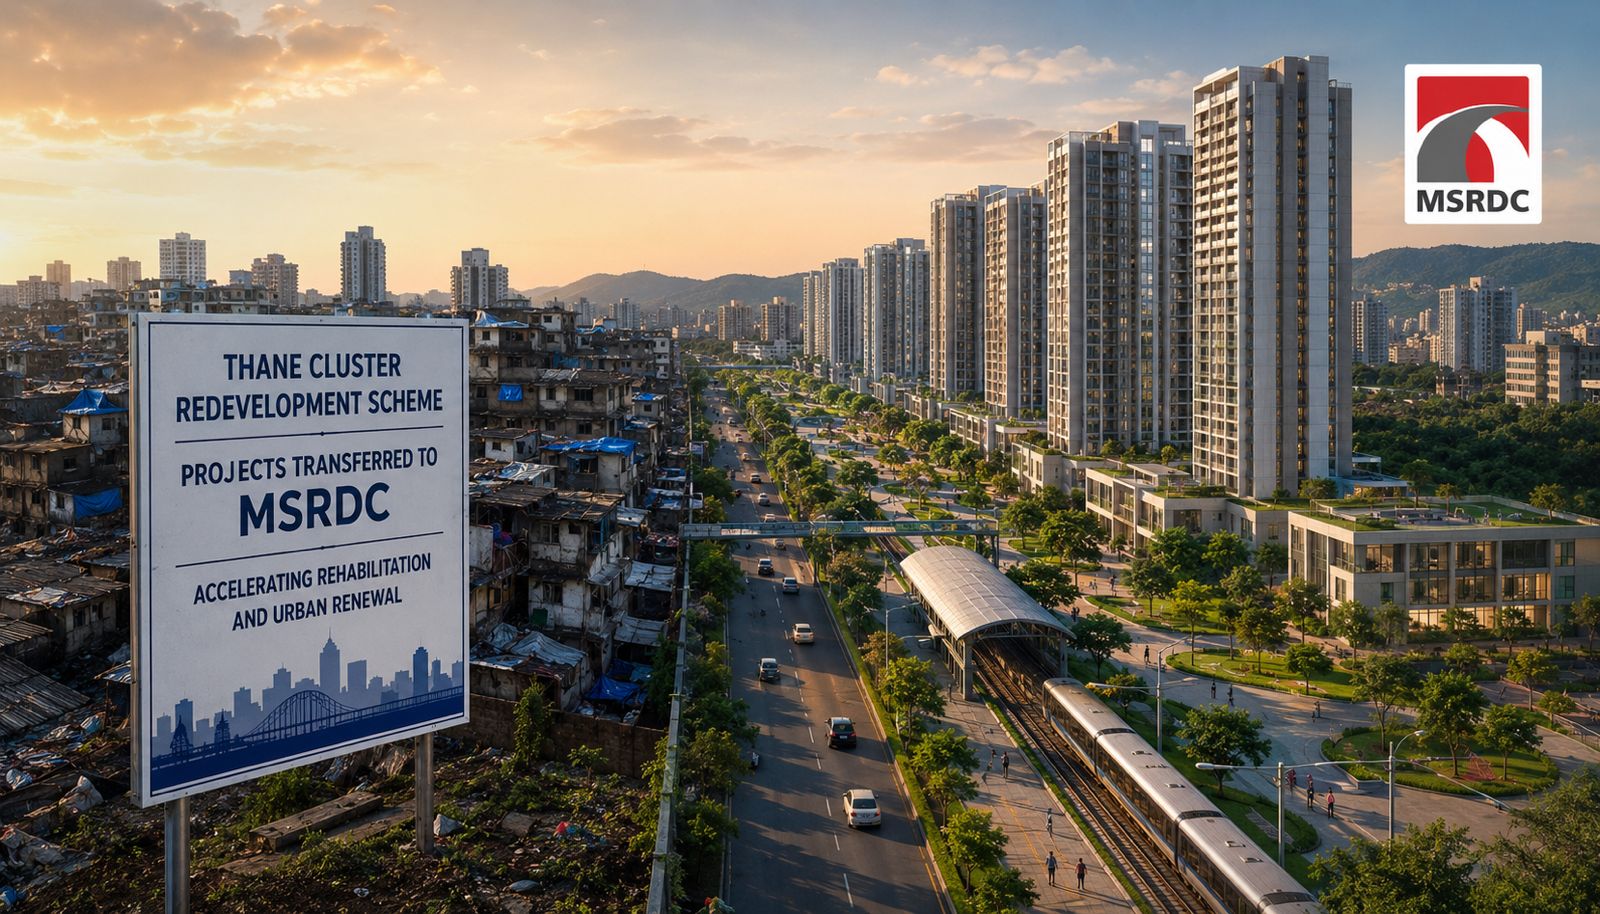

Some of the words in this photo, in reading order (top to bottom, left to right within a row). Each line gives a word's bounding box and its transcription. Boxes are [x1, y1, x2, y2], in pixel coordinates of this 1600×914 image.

[223, 354, 302, 381] THANE
[309, 353, 402, 379] CLUSTER
[176, 391, 363, 423] REDEVELOPMENT
[367, 389, 443, 415] SCHEME
[181, 457, 287, 487] PROJECTS
[291, 449, 413, 477] TRANSFERRED
[418, 447, 438, 467] TO
[239, 481, 391, 537] MSRDC
[193, 569, 313, 606] ACCELERATING
[317, 553, 431, 586] REHABILITATION
[231, 608, 268, 632] AND
[273, 598, 327, 624] URBAN
[332, 585, 403, 614] RENEWAL
